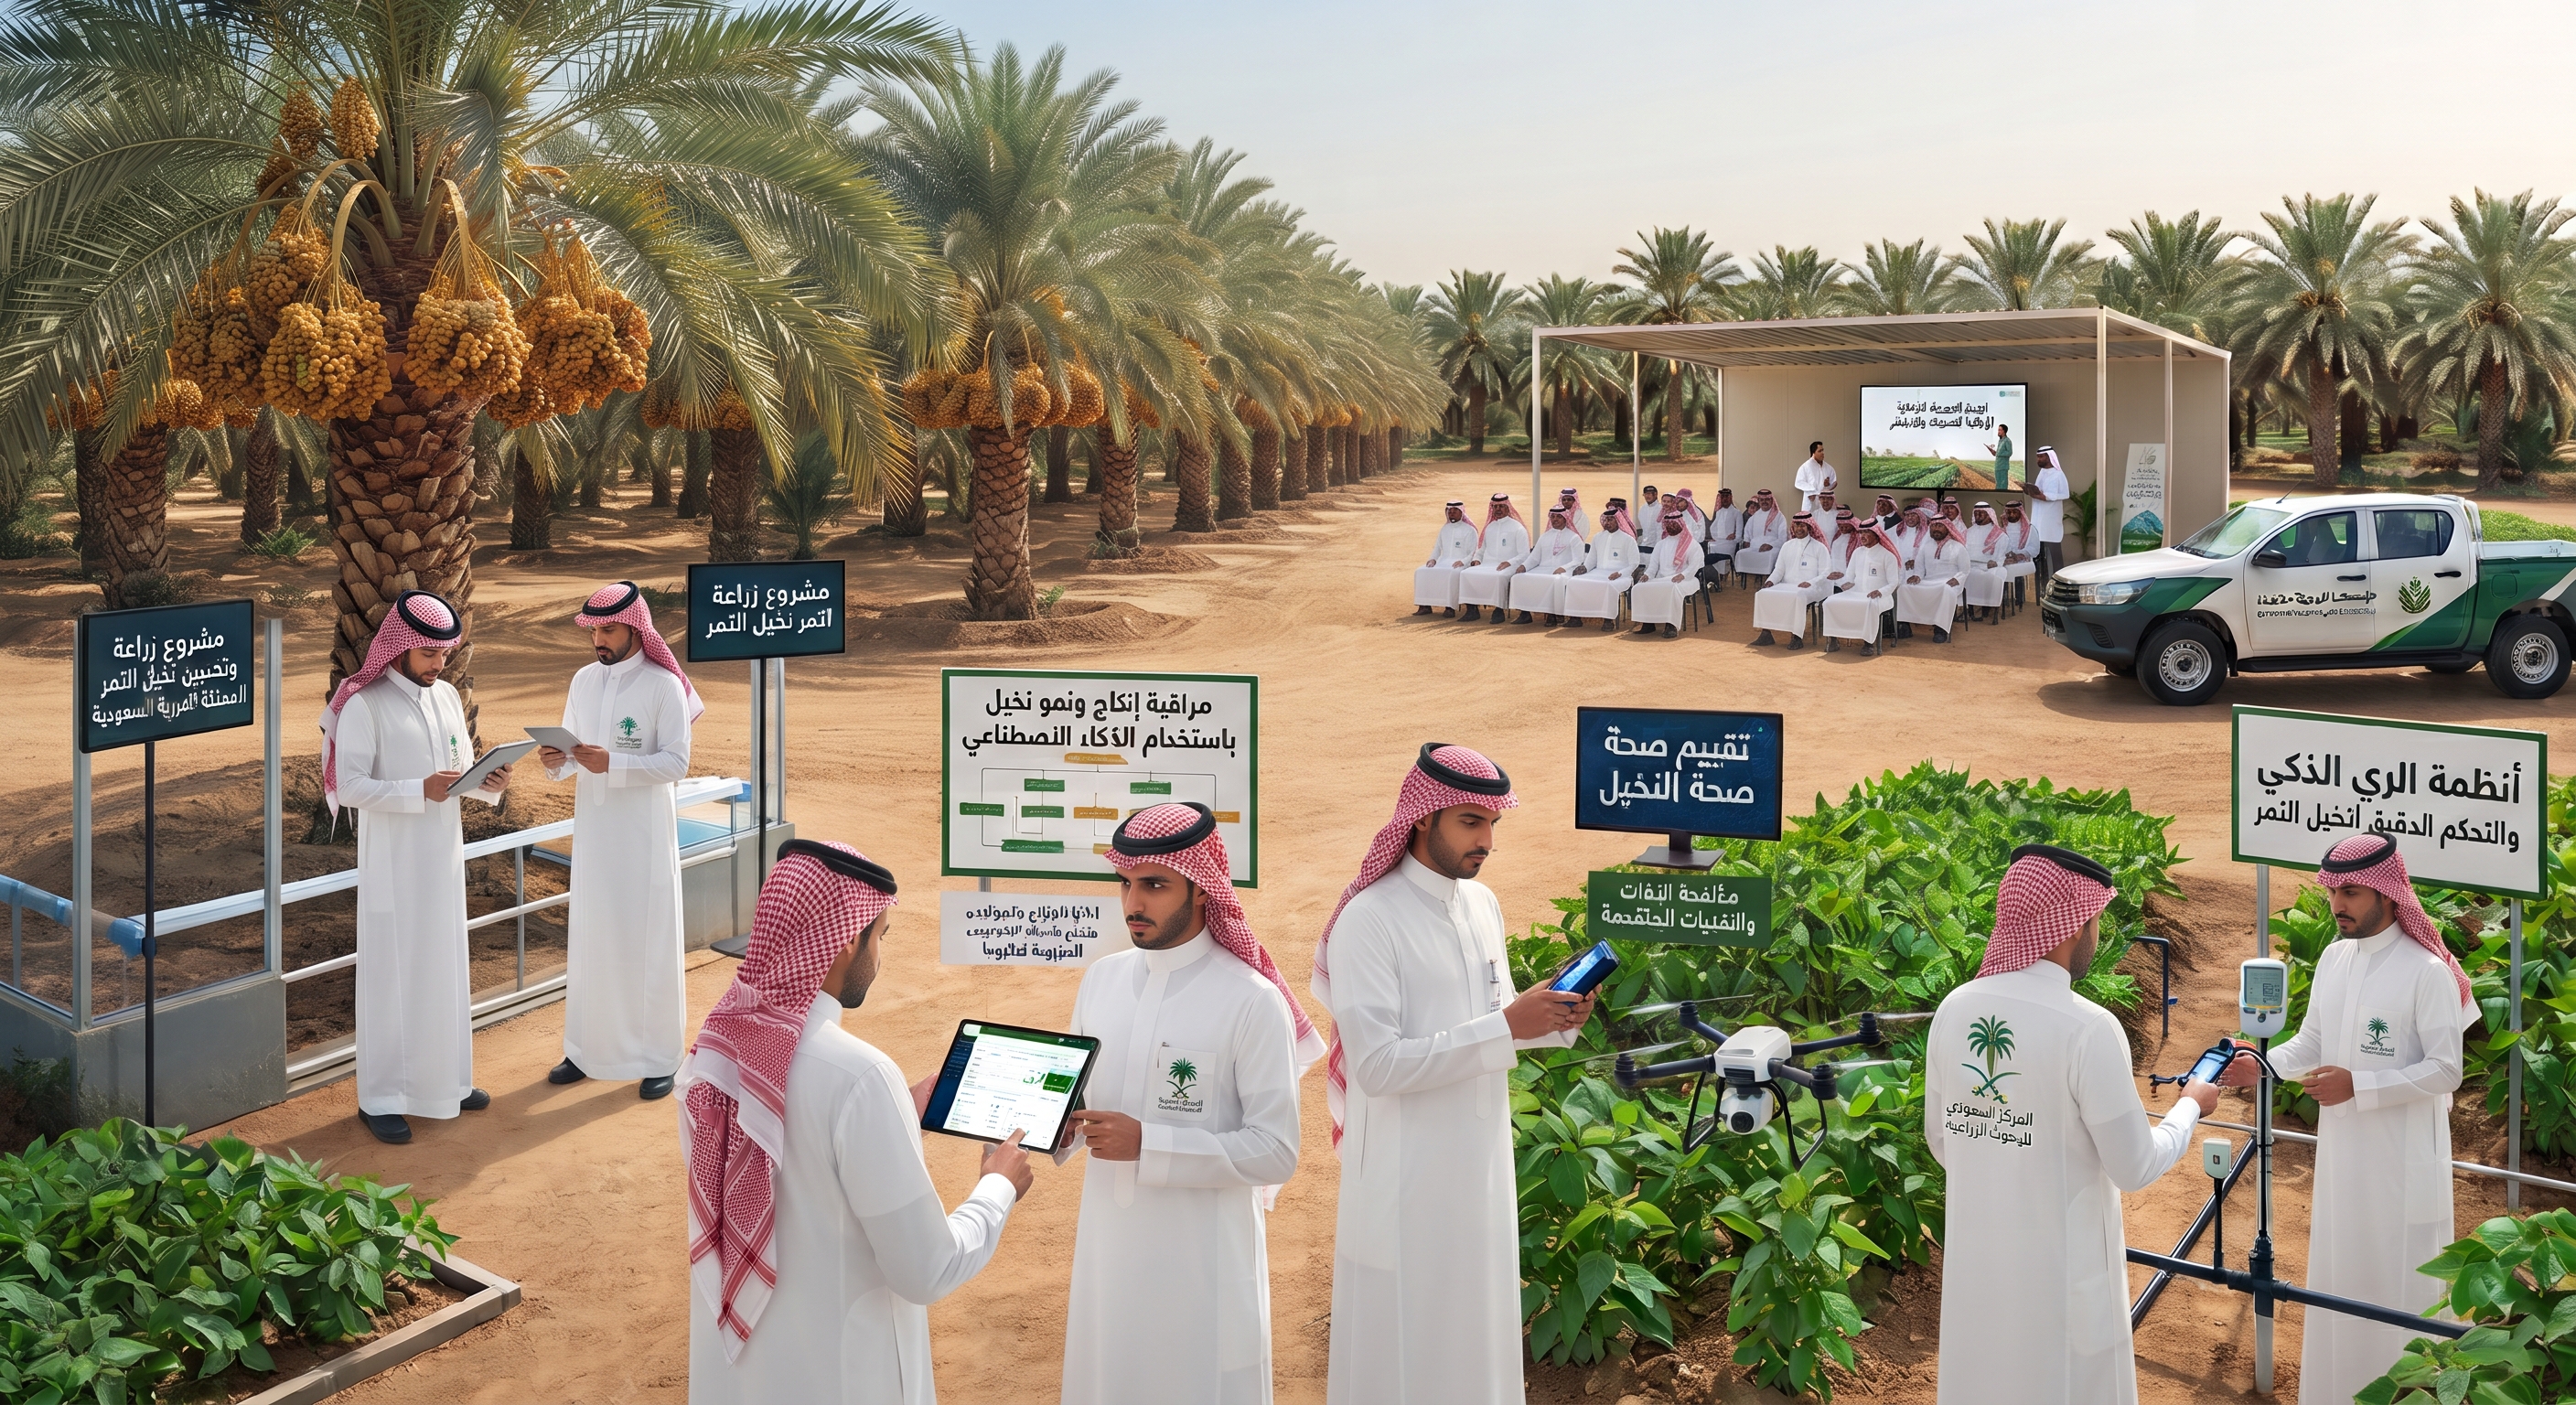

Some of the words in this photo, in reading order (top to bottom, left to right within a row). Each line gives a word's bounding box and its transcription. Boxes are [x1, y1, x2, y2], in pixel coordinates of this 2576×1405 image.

[713, 584, 758, 608] زراعة
[766, 579, 830, 610] مشروع
[113, 634, 156, 662] زراعة
[163, 627, 224, 662] مشروع
[101, 667, 137, 699] التمر
[985, 689, 1032, 716] نخيل
[1039, 691, 1086, 719] ونمو
[1605, 725, 1668, 757] صحة
[1599, 770, 1679, 809] النخيل
[1689, 773, 1755, 804] صحة
[2258, 752, 2341, 796] الذكي
[2352, 761, 2416, 803] الري
[2429, 761, 2522, 804] أنظمة
